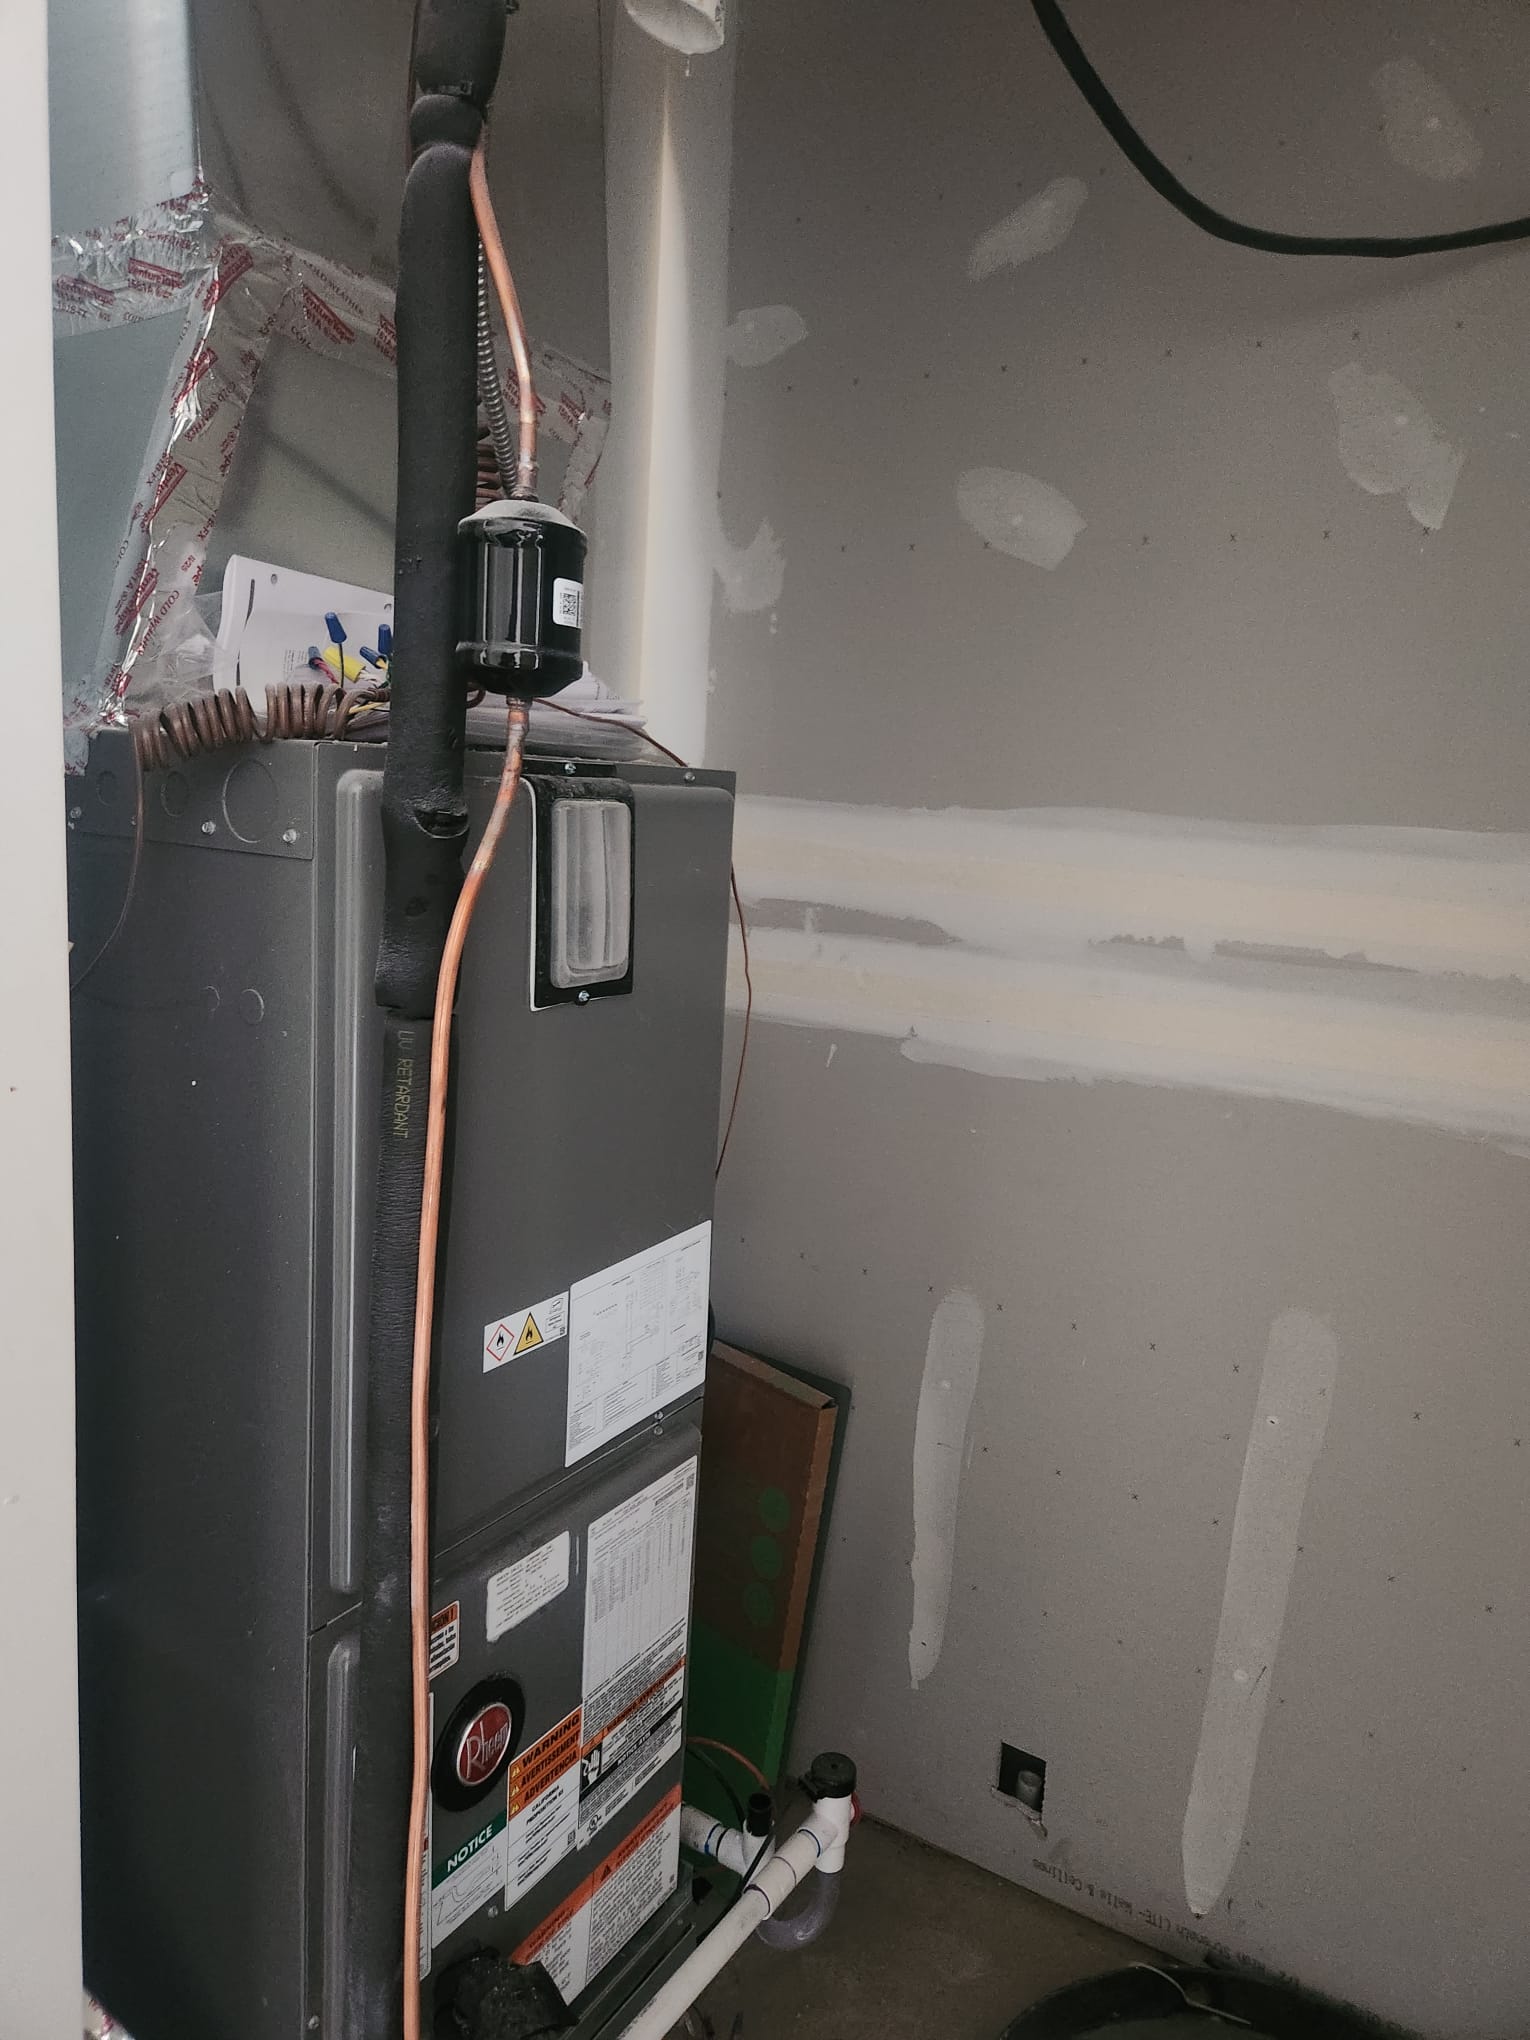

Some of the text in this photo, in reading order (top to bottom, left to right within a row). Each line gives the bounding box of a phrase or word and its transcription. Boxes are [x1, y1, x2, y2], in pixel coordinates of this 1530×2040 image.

[159, 589, 180, 616] COLD
[393, 1058, 414, 1139] RETARDANT
[466, 1720, 509, 1779] Rheem
[521, 1730, 581, 1787] AVERTISSEMENT
[522, 1714, 580, 1769] WARNING
[524, 1749, 578, 1803] ADVERTENCIA
[447, 1824, 494, 1873] NOTICE
